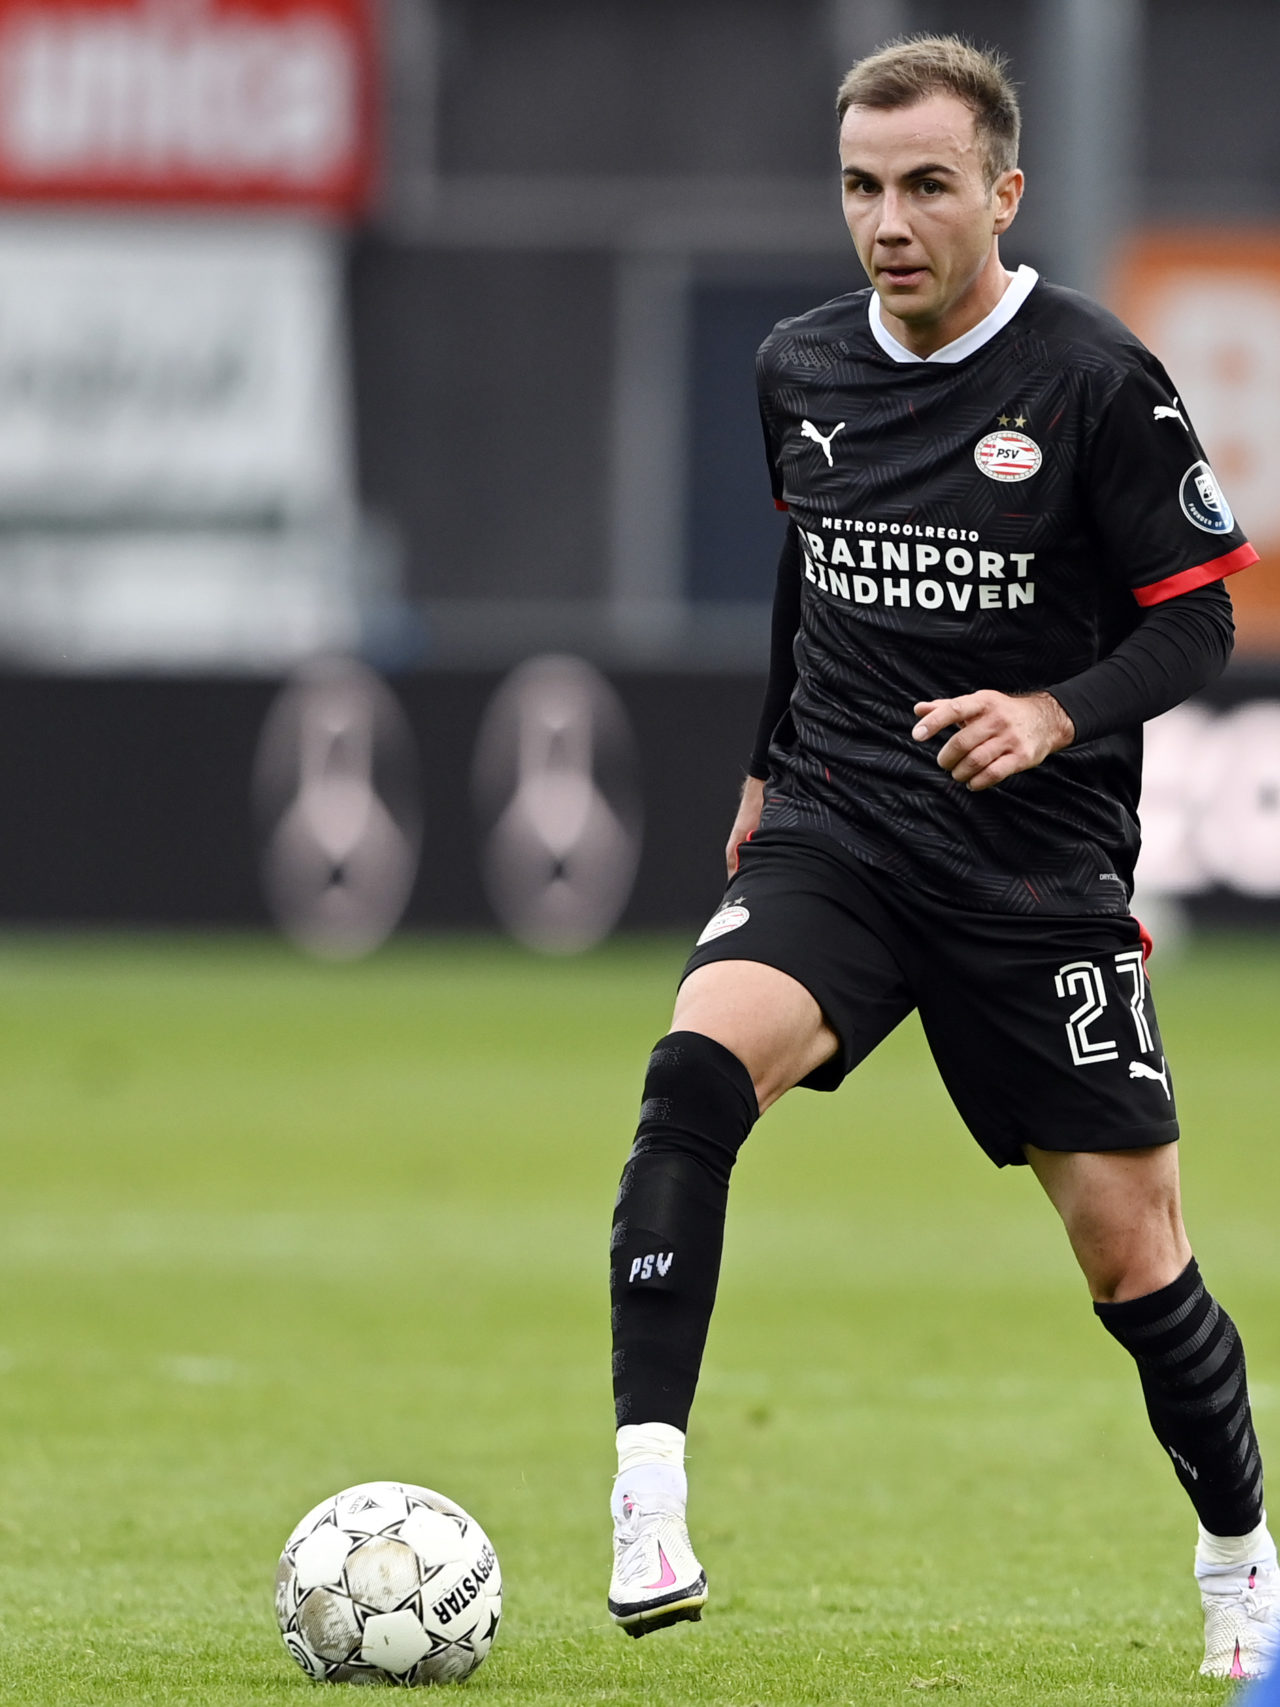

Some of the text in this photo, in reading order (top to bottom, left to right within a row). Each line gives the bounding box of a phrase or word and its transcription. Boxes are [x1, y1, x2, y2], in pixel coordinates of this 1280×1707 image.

[996, 448, 1020, 460] PSV
[822, 517, 979, 542] METROPOOLREGIO
[797, 525, 1035, 578] RAINPORT
[804, 551, 1035, 612] EINDHOVEN
[1054, 950, 1155, 1066] 27
[628, 1252, 674, 1283] PSV
